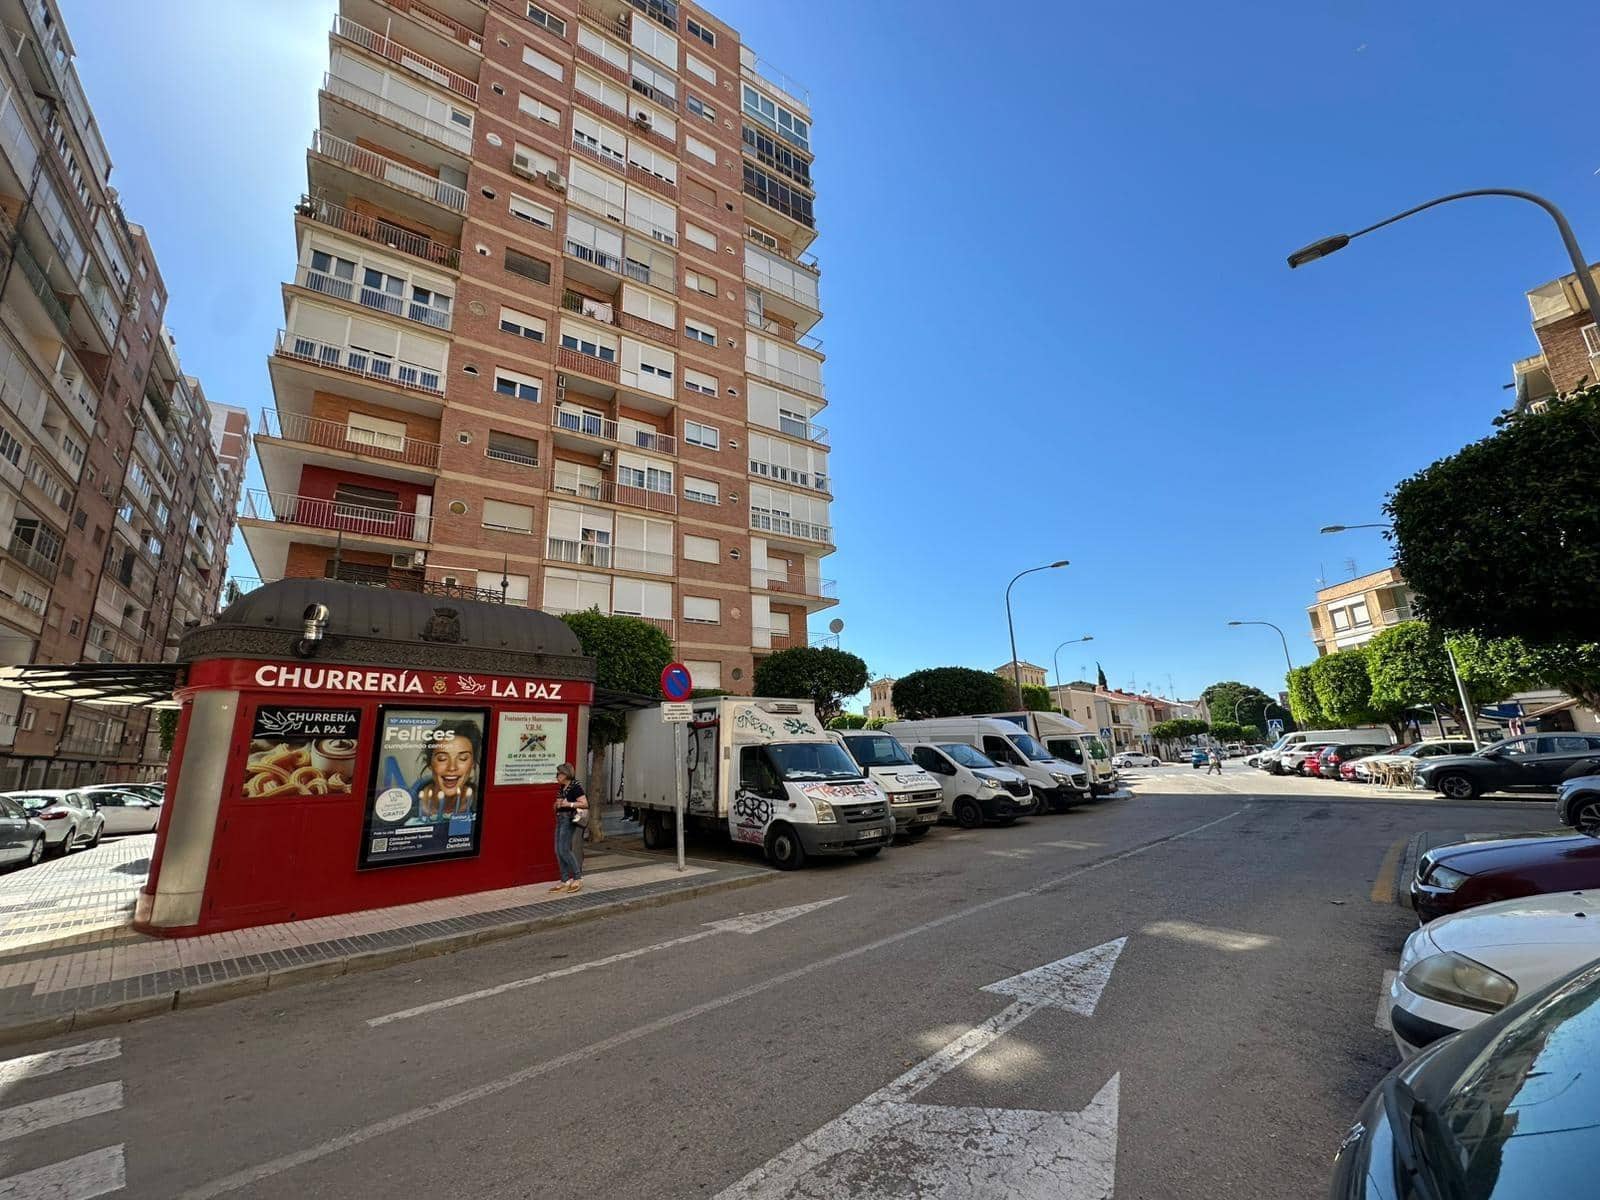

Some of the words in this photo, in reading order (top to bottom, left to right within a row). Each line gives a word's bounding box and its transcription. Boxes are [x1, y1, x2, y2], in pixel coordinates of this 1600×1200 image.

[255, 664, 424, 693] CHURRERÍA
[491, 679, 518, 698] LA
[525, 682, 562, 700] PAZ
[287, 711, 356, 722] CHURRERÍA
[304, 725, 320, 734] LA
[323, 725, 346, 734] PAZ
[385, 725, 456, 741] Felices
